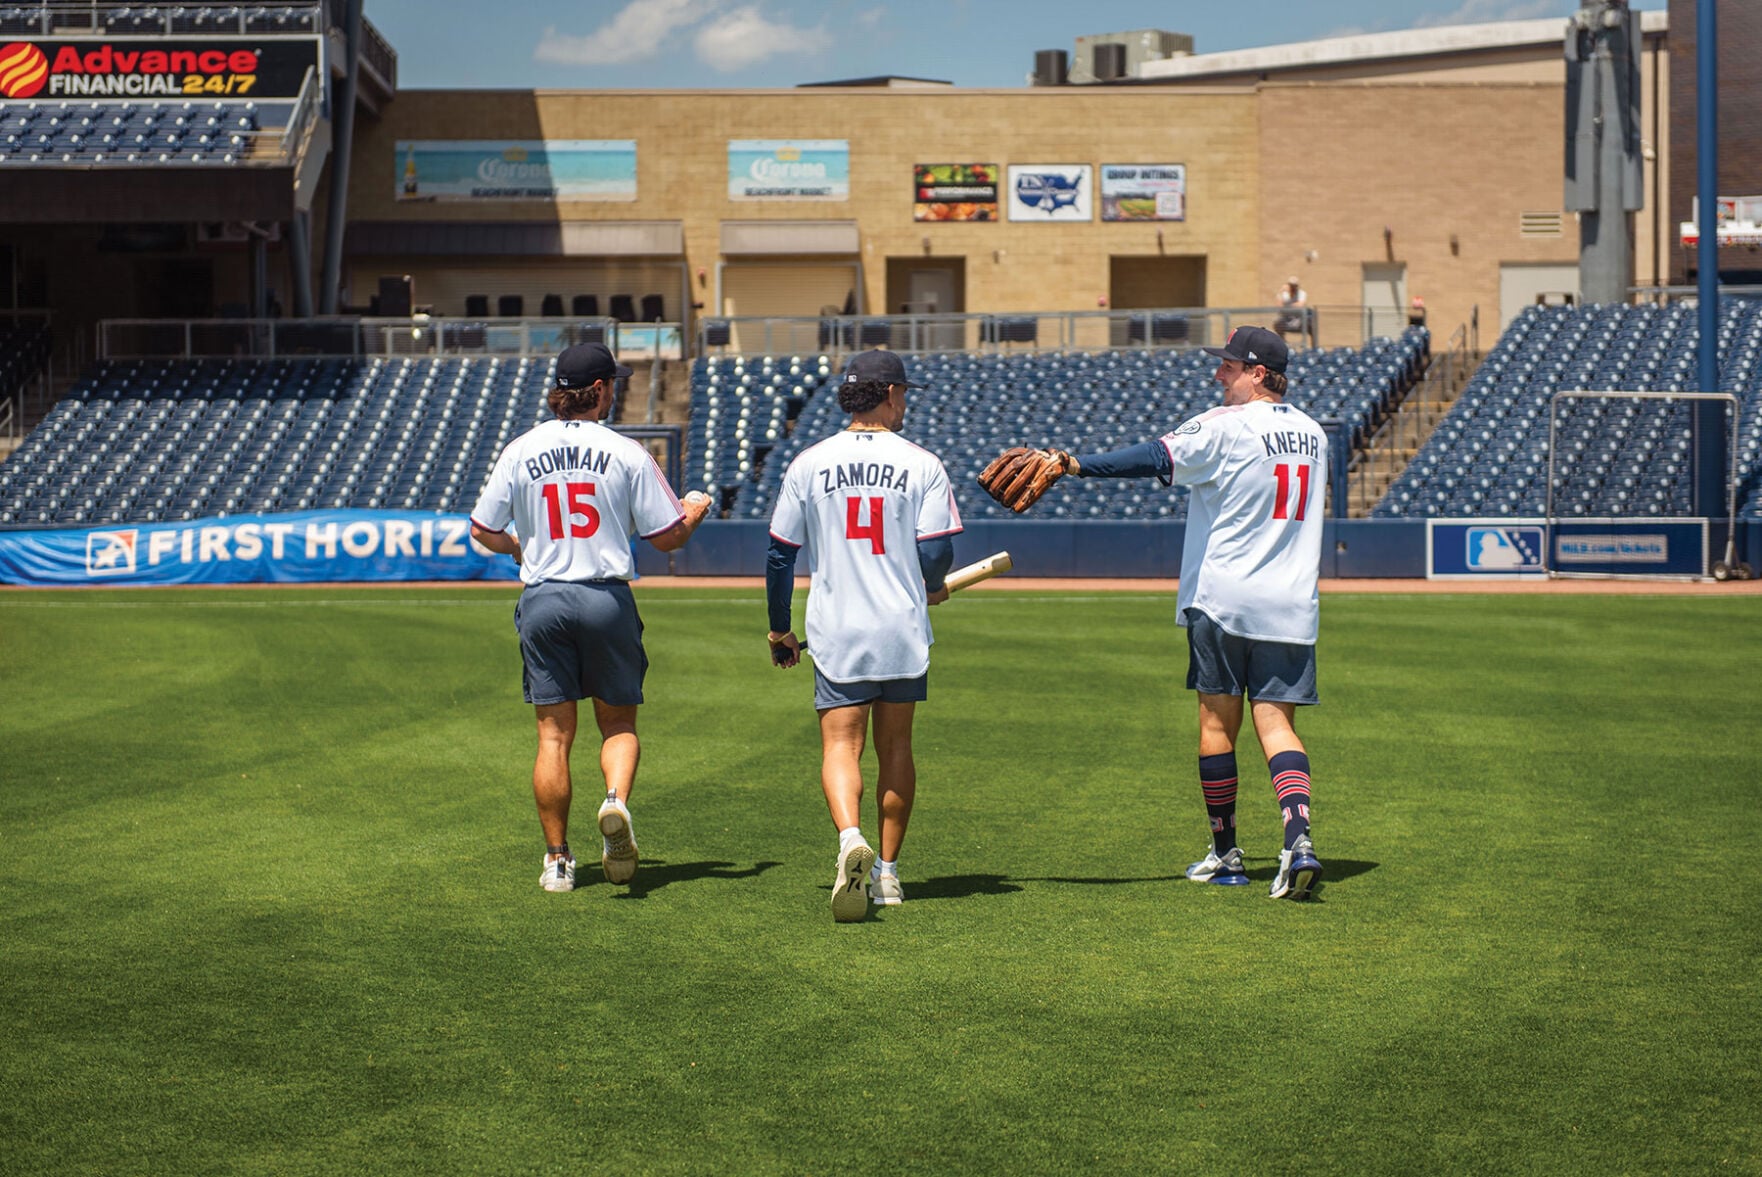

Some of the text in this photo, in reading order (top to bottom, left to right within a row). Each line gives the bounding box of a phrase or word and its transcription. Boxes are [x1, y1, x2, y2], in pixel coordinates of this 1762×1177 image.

[52, 45, 258, 74] Advance
[749, 157, 827, 182] Corona
[1261, 431, 1319, 458] KNEHR
[525, 446, 612, 481] BOWMAN
[819, 461, 910, 494] ZAMORA
[1273, 463, 1311, 522] 11
[541, 482, 601, 541] 15
[846, 496, 886, 555] 4
[148, 518, 496, 566] FIRST HORIZ
